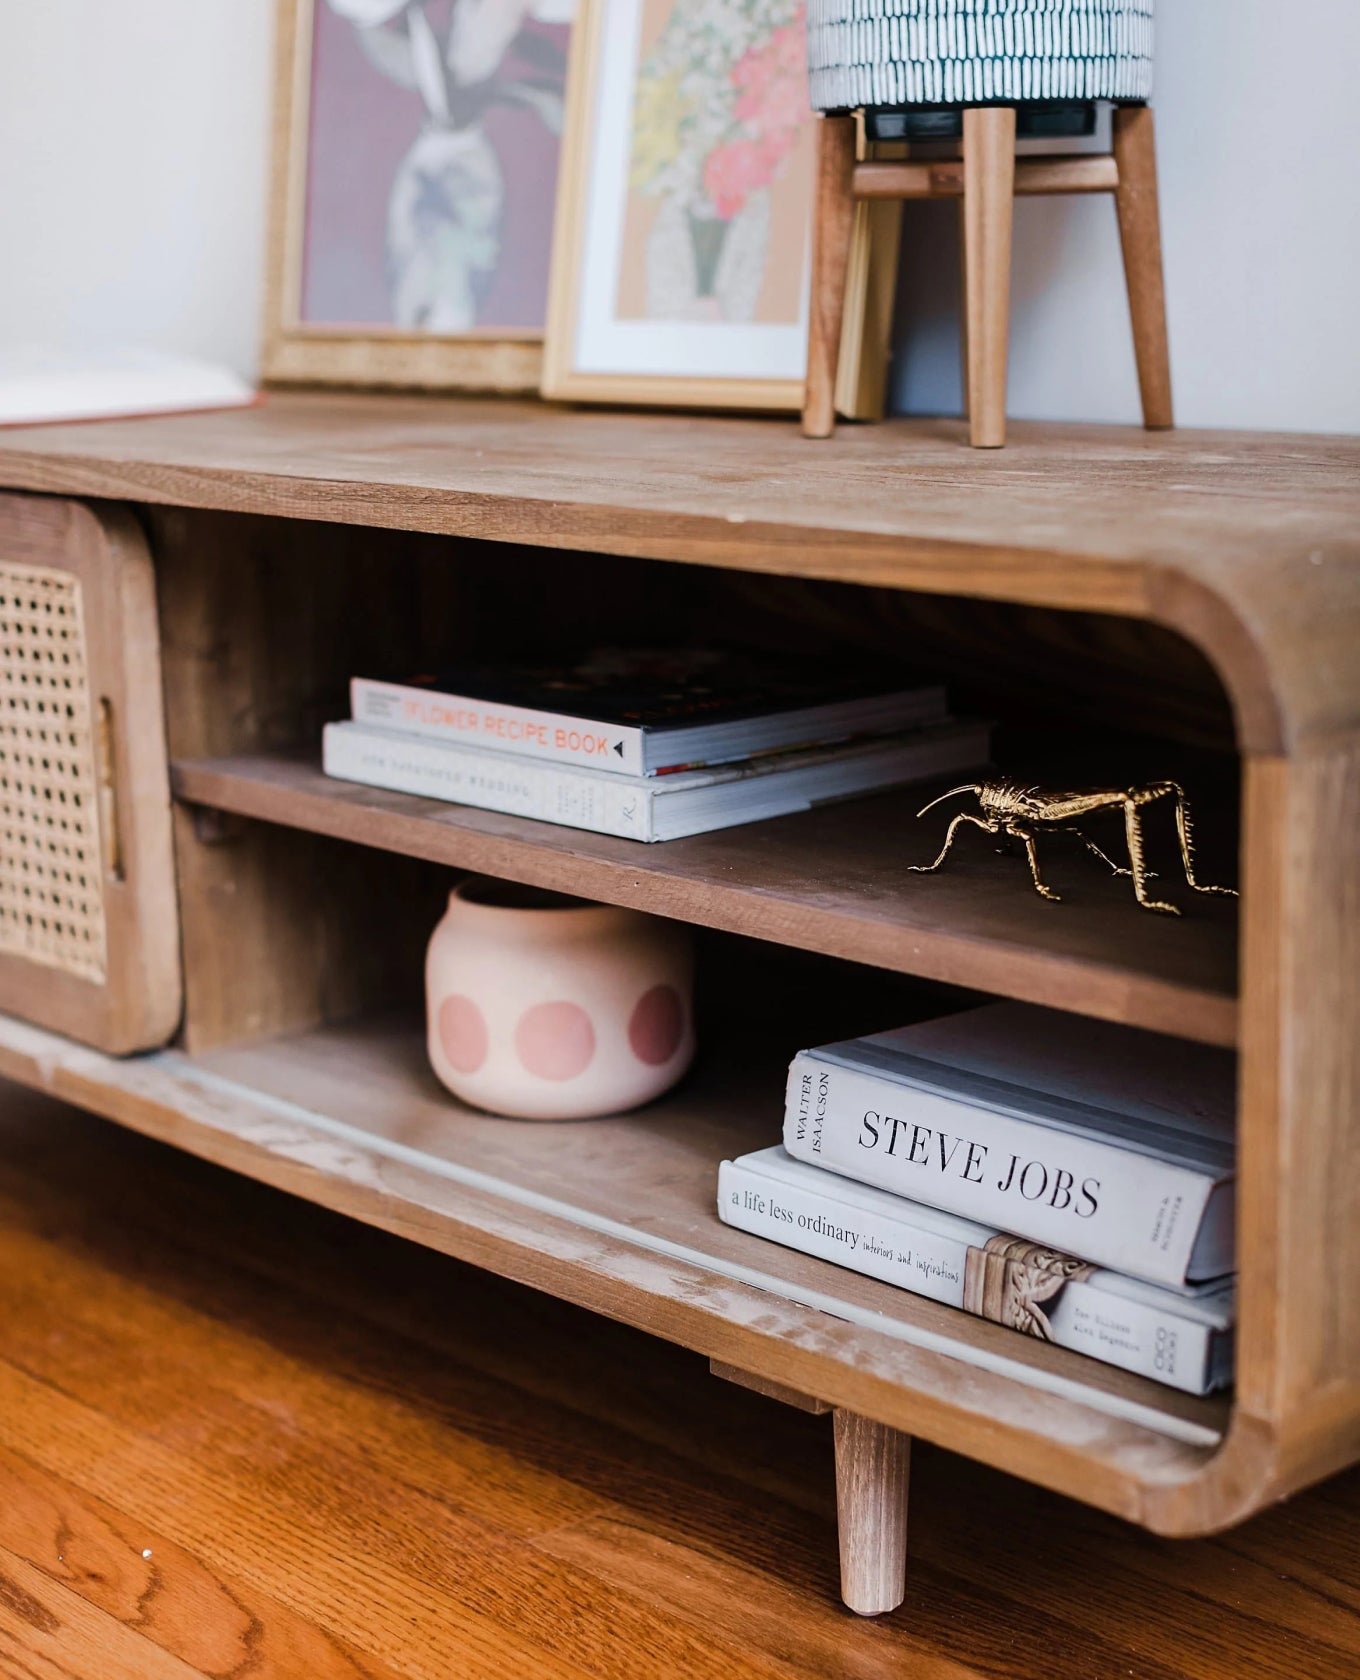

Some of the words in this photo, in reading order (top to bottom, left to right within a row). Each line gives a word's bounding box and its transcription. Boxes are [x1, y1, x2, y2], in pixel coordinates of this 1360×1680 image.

[484, 714, 549, 746] RECIPE
[555, 728, 609, 756] BOOK
[797, 1074, 813, 1140] WALTER
[812, 1072, 830, 1153] ISAACSON
[858, 1110, 989, 1184] STEVE
[997, 1153, 1101, 1218] JOBS
[731, 1191, 740, 1206] a
[744, 1190, 766, 1214] life
[769, 1199, 794, 1224] less
[797, 1215, 860, 1250] ordinary
[863, 1235, 893, 1261] interiors
[897, 1250, 912, 1266] and
[916, 1253, 959, 1283] inspirations
